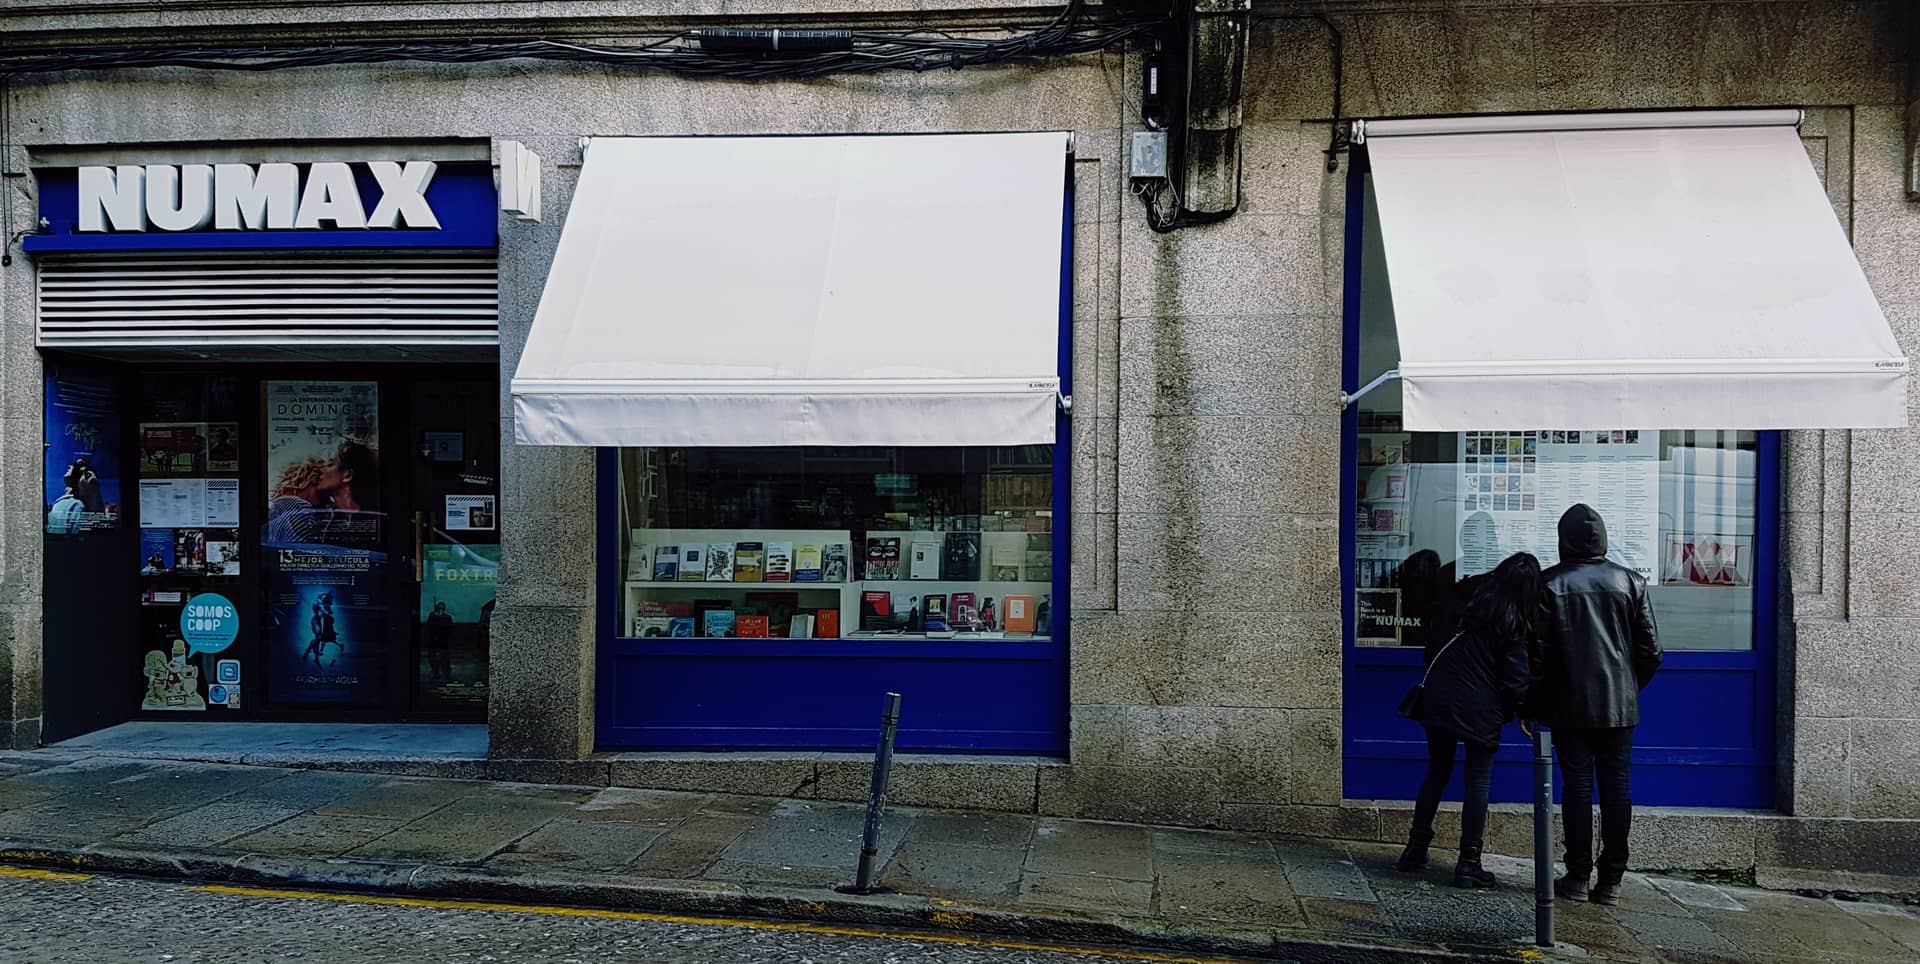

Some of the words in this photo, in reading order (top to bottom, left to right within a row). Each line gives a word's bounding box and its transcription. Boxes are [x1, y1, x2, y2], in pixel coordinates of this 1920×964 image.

[78, 161, 441, 231] NUMAX
[278, 403, 366, 415] DOMINGO
[278, 550, 294, 563] 13
[187, 604, 232, 618] SOMOS
[187, 618, 221, 631] COOP
[1375, 615, 1422, 626] NUMAX
